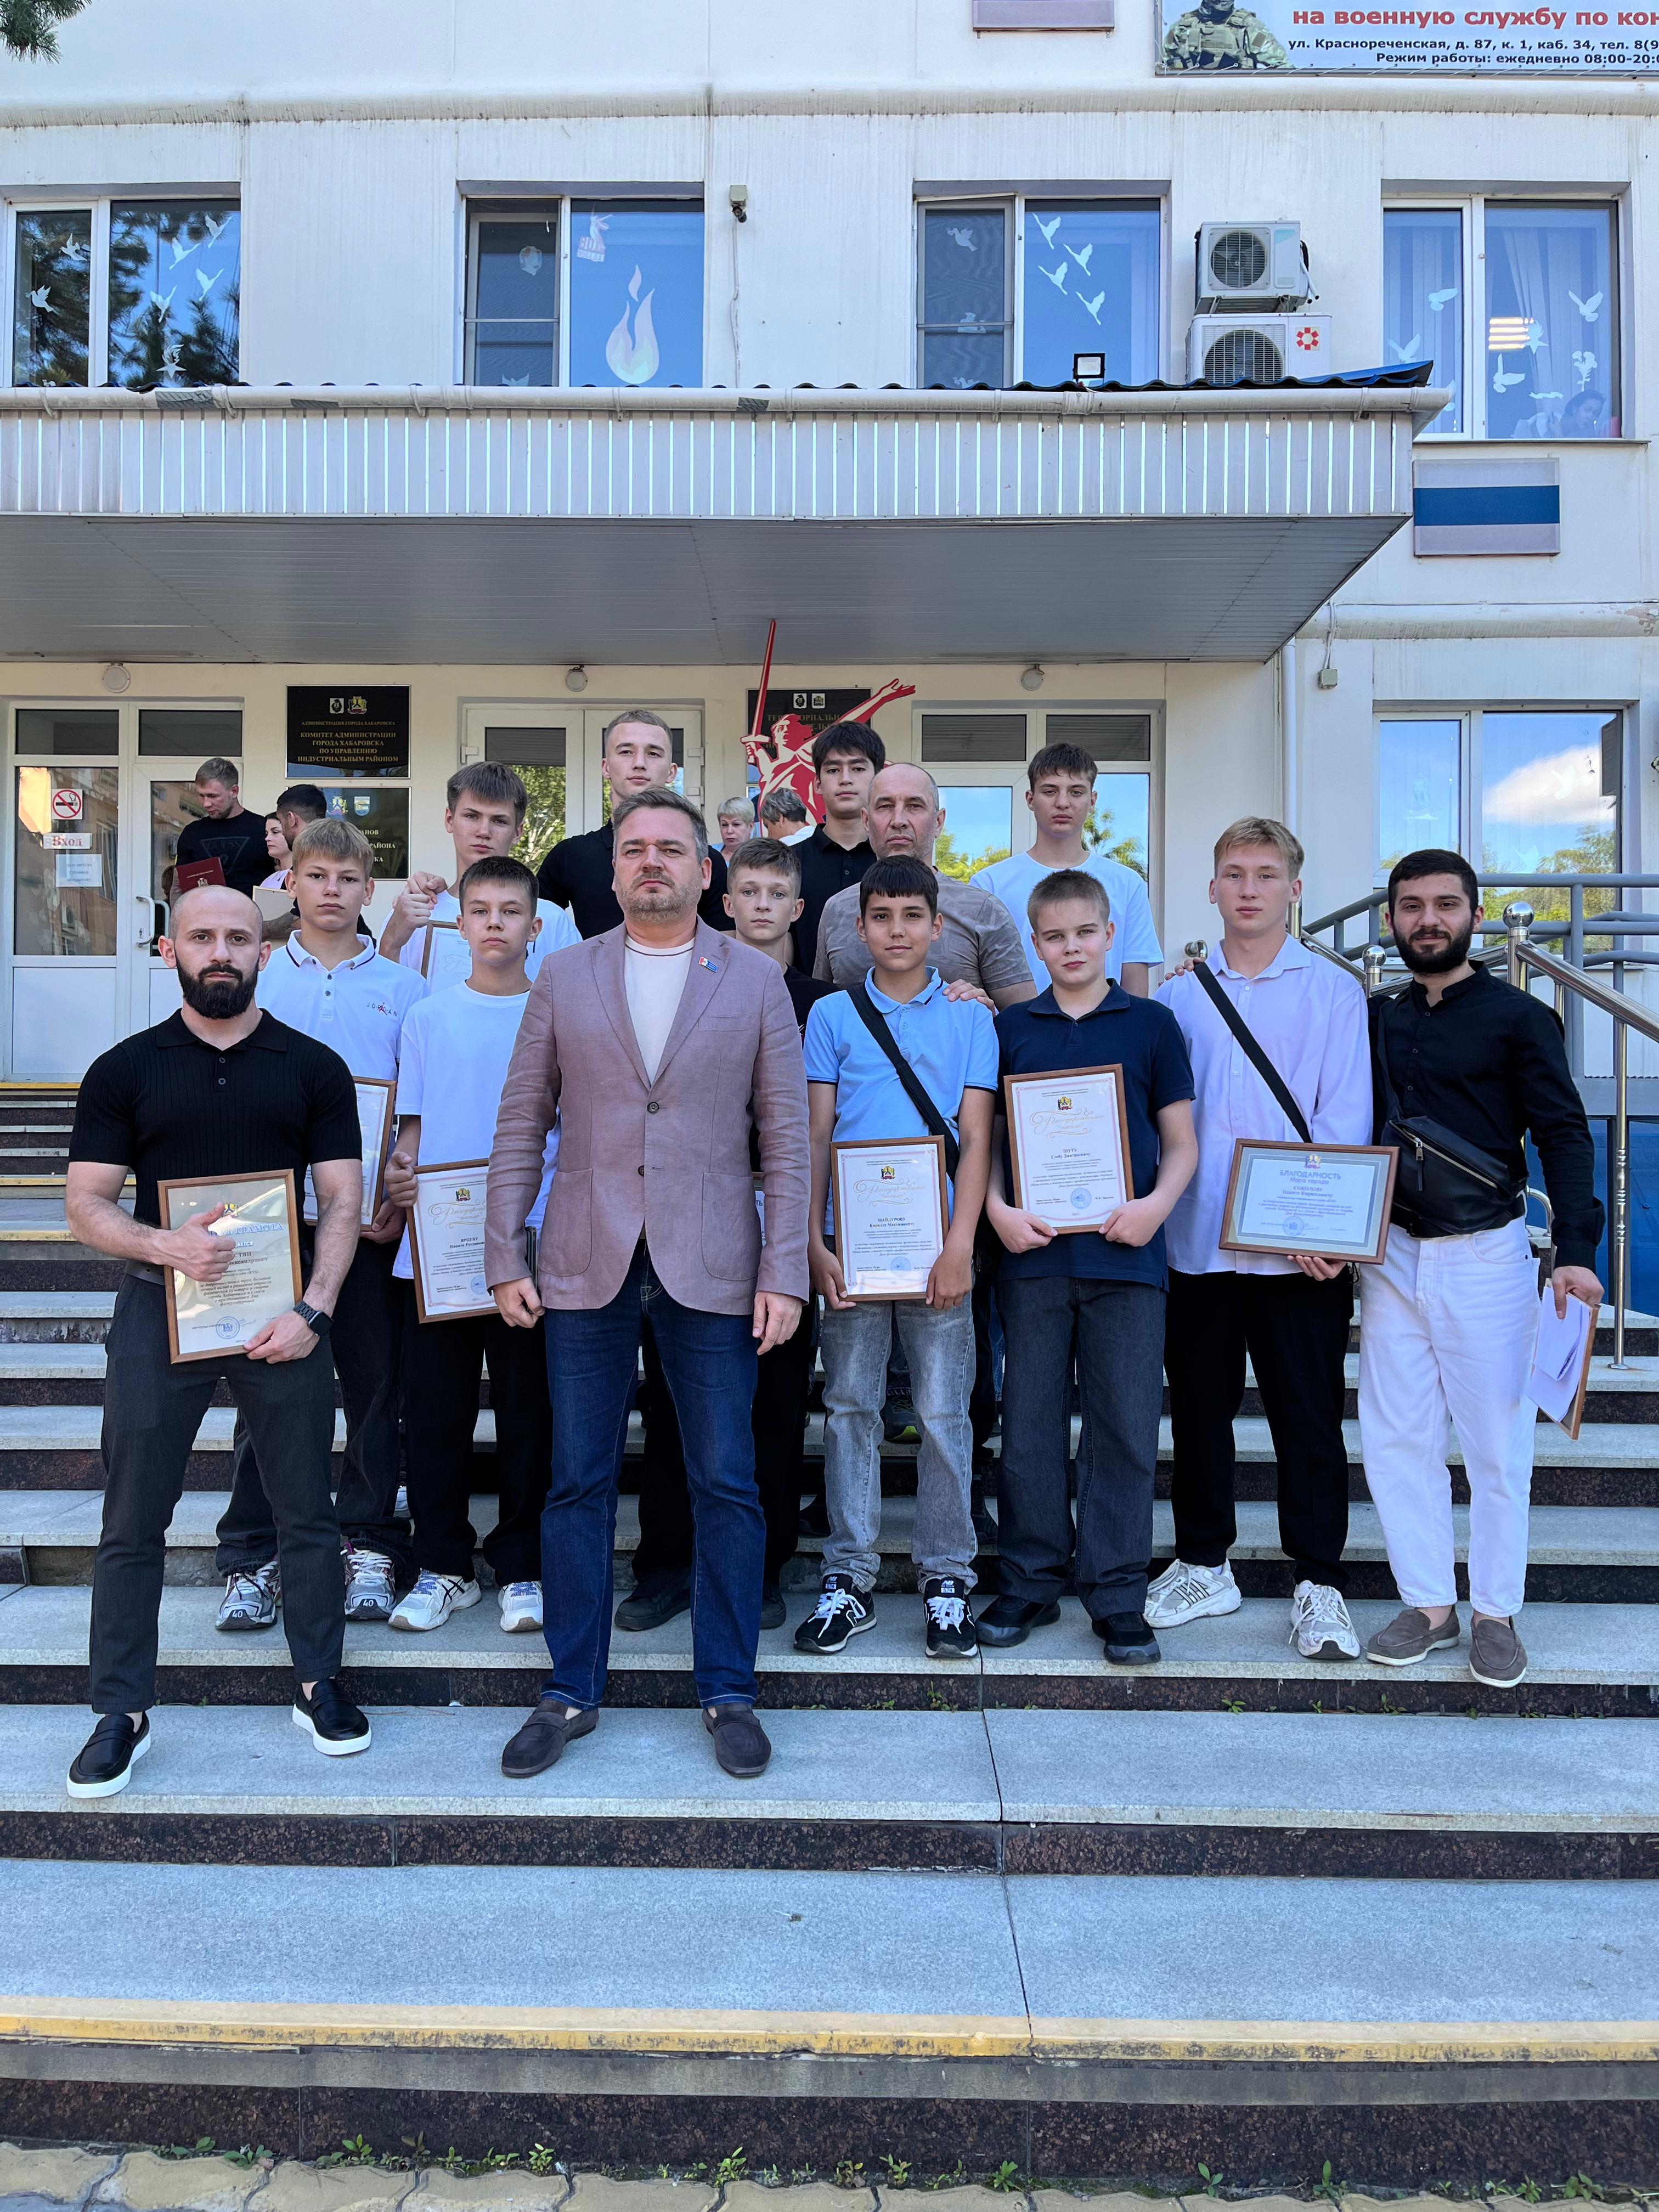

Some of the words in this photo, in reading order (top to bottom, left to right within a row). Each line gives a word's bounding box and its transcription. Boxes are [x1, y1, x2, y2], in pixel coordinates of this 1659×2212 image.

[1293, 11, 1324, 25] на
[1334, 11, 1455, 29] военную
[1464, 7, 1567, 29] службу
[1576, 12, 1608, 25] по
[1288, 39, 1310, 50] ул.
[1315, 39, 1451, 50] Краснореченская,
[1455, 41, 1469, 49] д.
[1474, 40, 1497, 50] 87,
[1520, 40, 1532, 50] 1,
[1537, 40, 1567, 49] каб.
[1572, 40, 1595, 51] 34,
[1376, 53, 1426, 62] Режим
[1432, 53, 1491, 64] работы:
[1496, 55, 1579, 64] ежедневно
[53, 836, 82, 847] Вход
[1279, 1170, 1341, 1180] БЛАГОДАРНОСТЬ
[236, 1222, 284, 1234] ГРАМОТА
[363, 1599, 374, 1607] 40
[232, 1609, 244, 1618] 40
